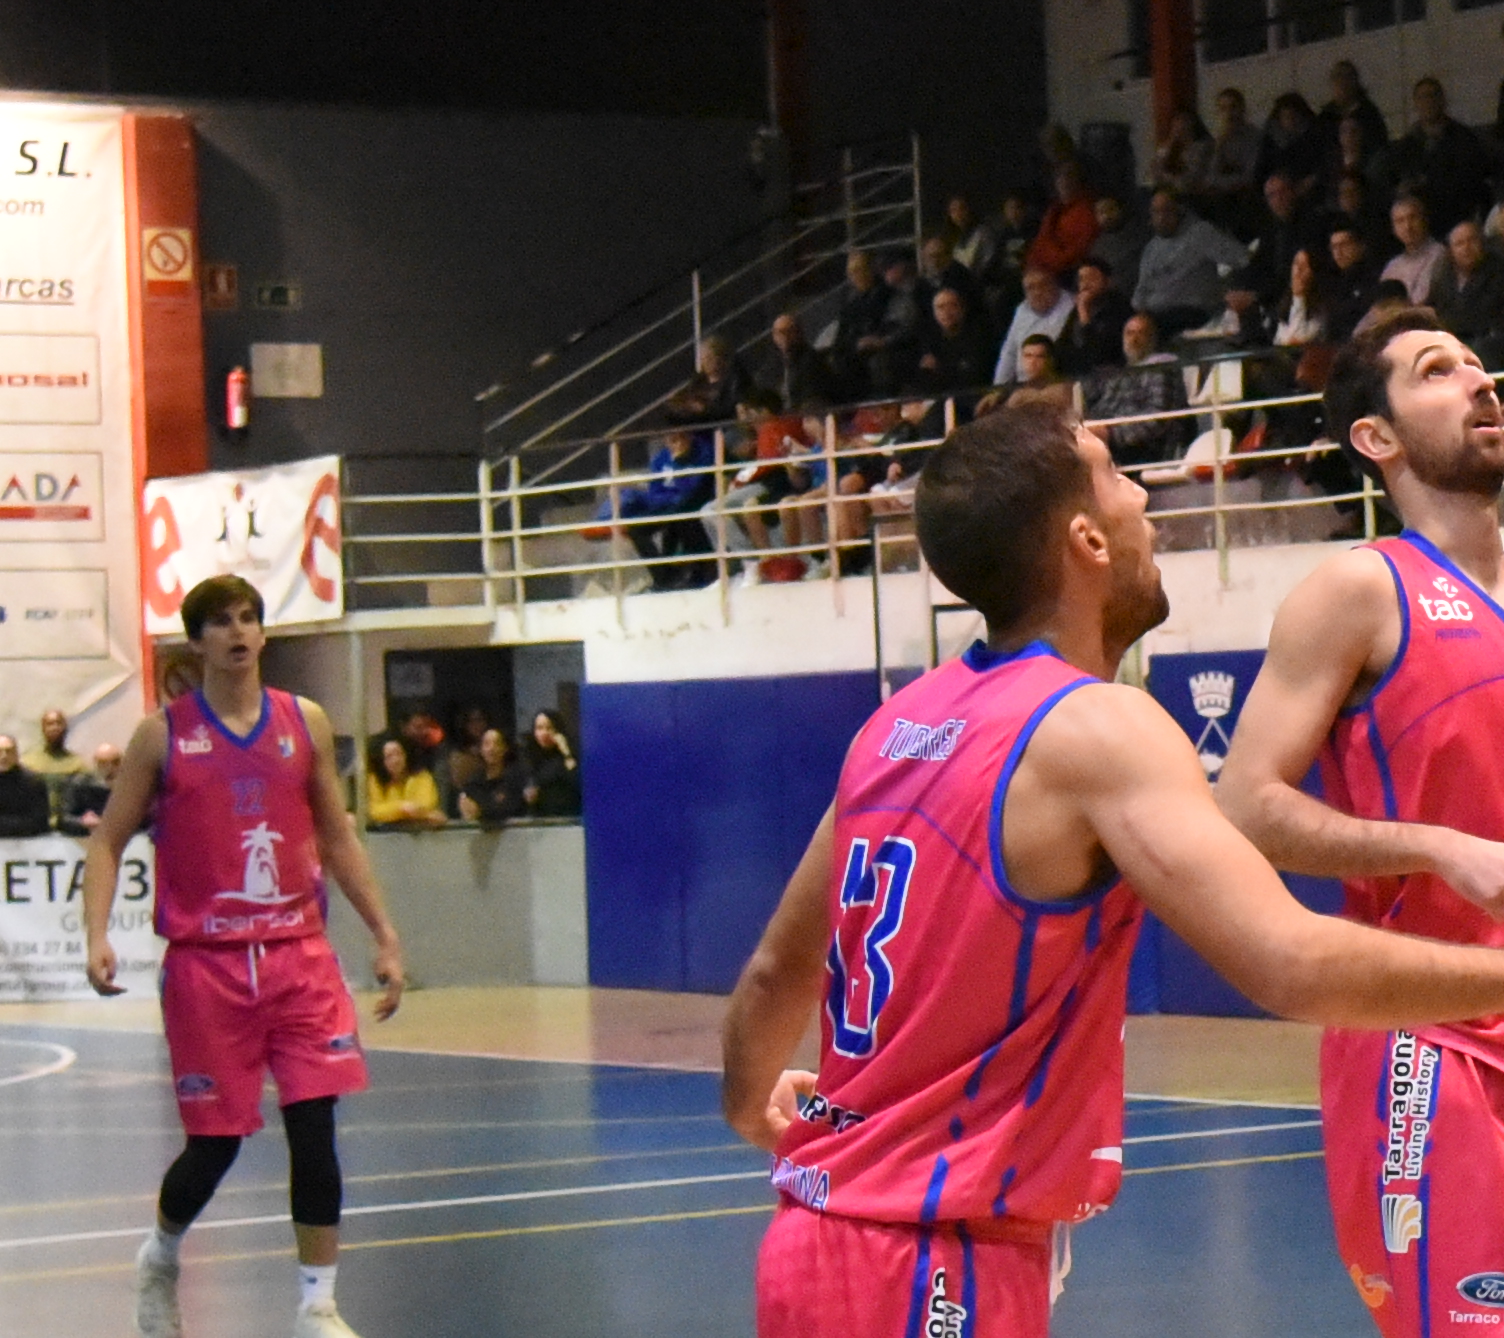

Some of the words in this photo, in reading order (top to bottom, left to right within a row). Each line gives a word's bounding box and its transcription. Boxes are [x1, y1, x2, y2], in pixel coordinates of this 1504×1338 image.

[15, 140, 93, 178] S.L.
[1418, 593, 1473, 621] tac
[1412, 1048, 1437, 1116] History
[1407, 1122, 1428, 1178] Living
[1448, 1310, 1501, 1324] Tarraco
